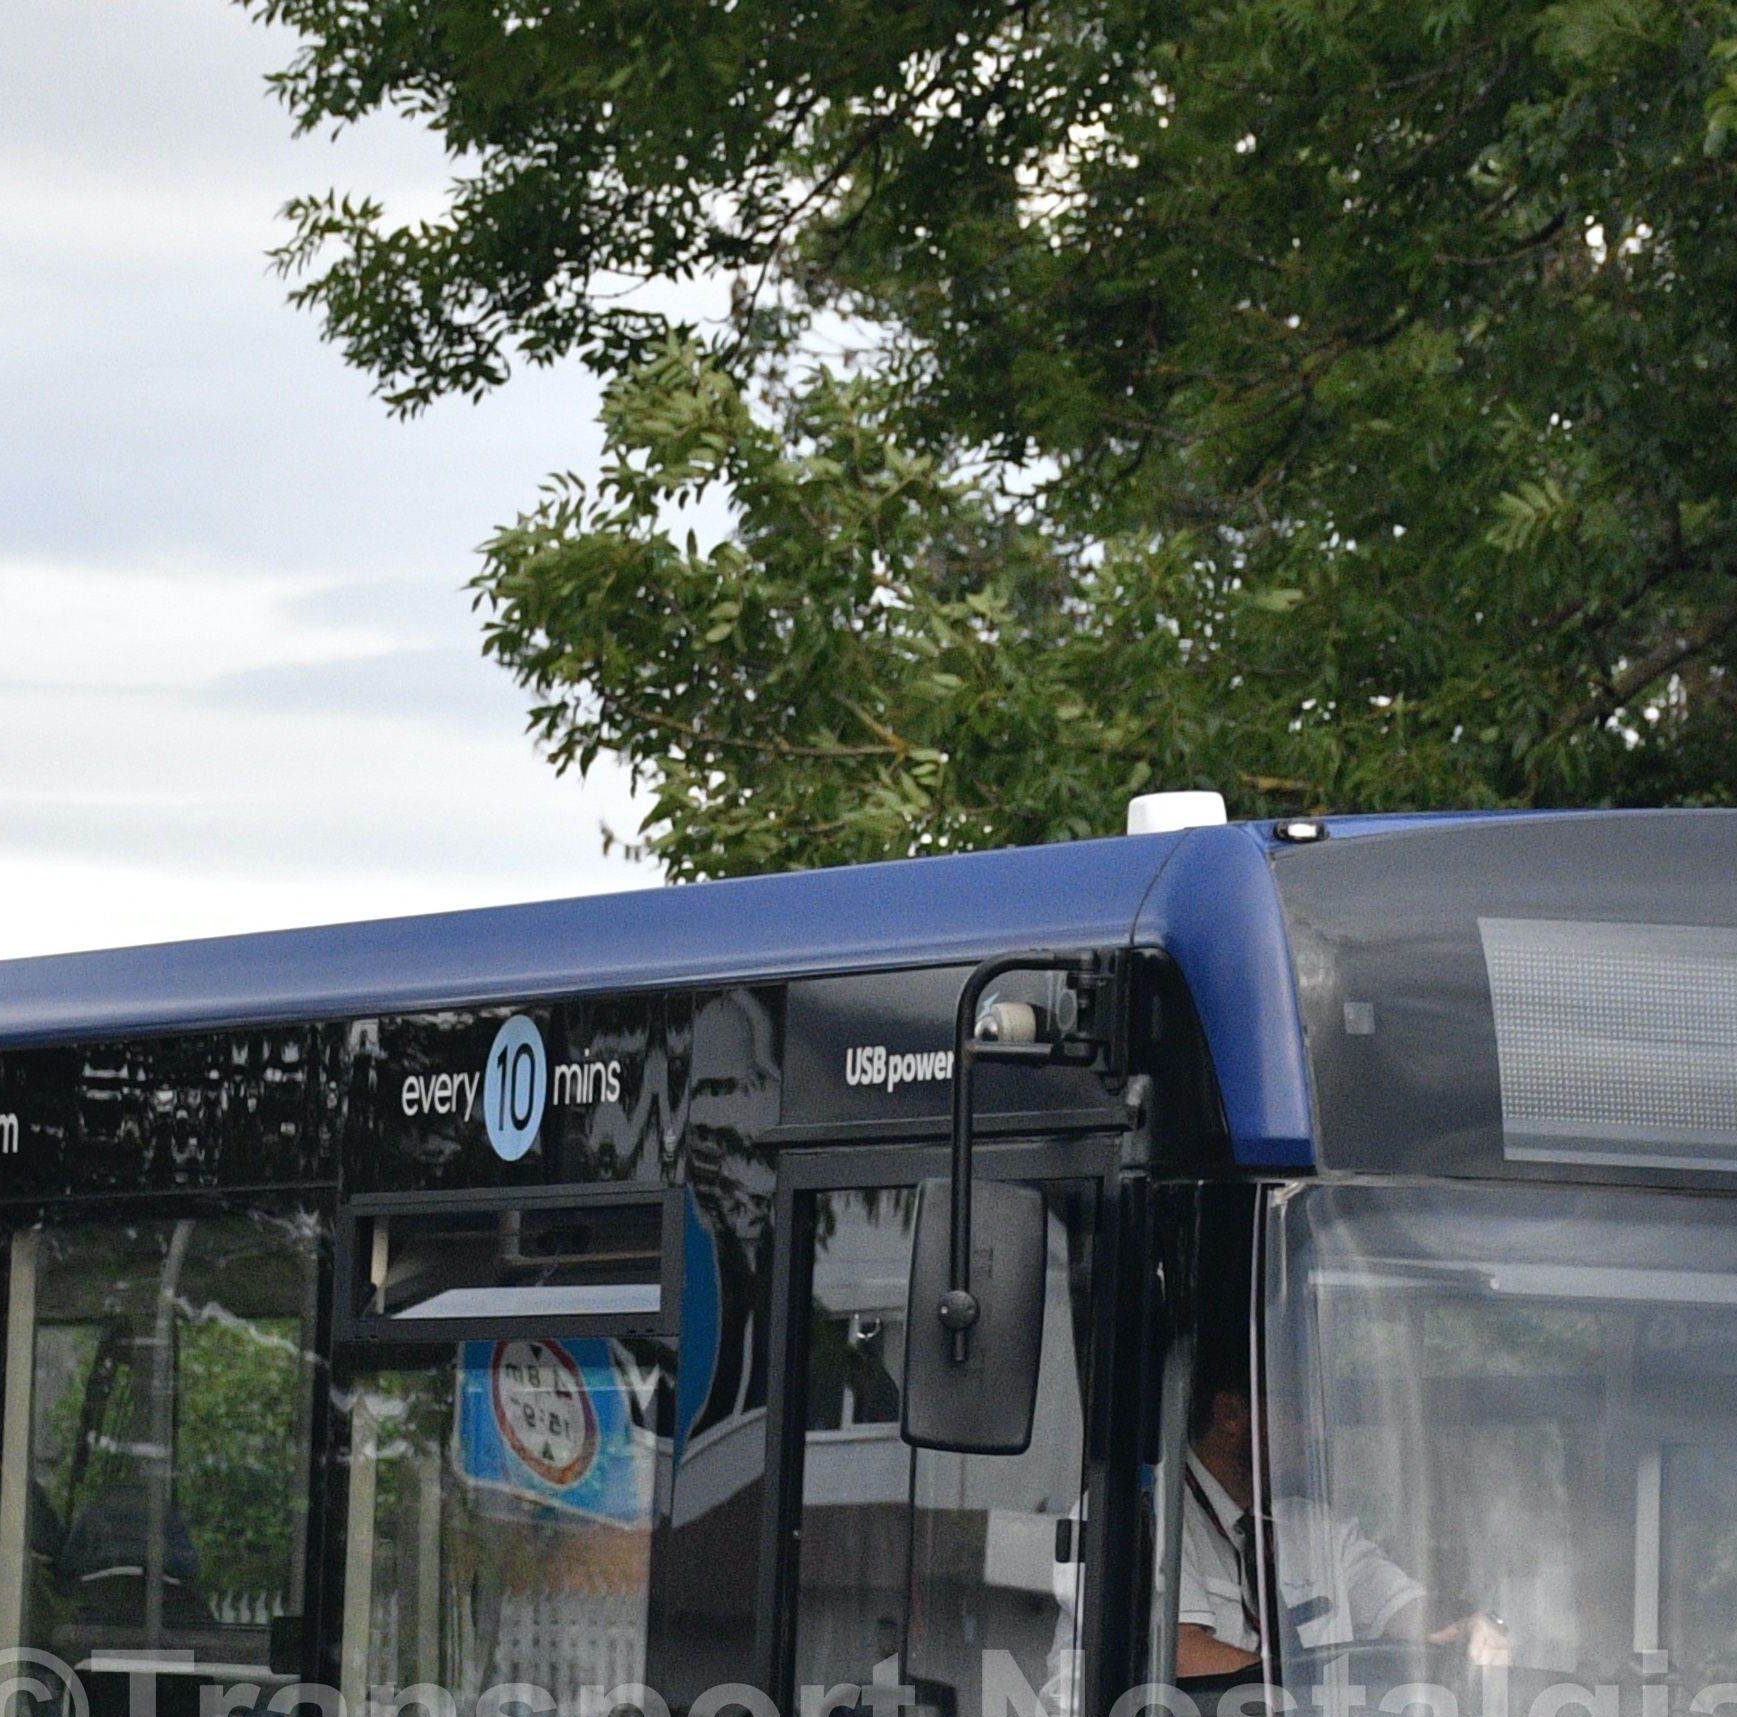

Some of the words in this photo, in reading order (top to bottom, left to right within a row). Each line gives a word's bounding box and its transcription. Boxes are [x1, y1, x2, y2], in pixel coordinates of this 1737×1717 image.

[401, 1072, 481, 1122] every
[496, 1043, 536, 1132] 10
[553, 1048, 622, 1105] mins
